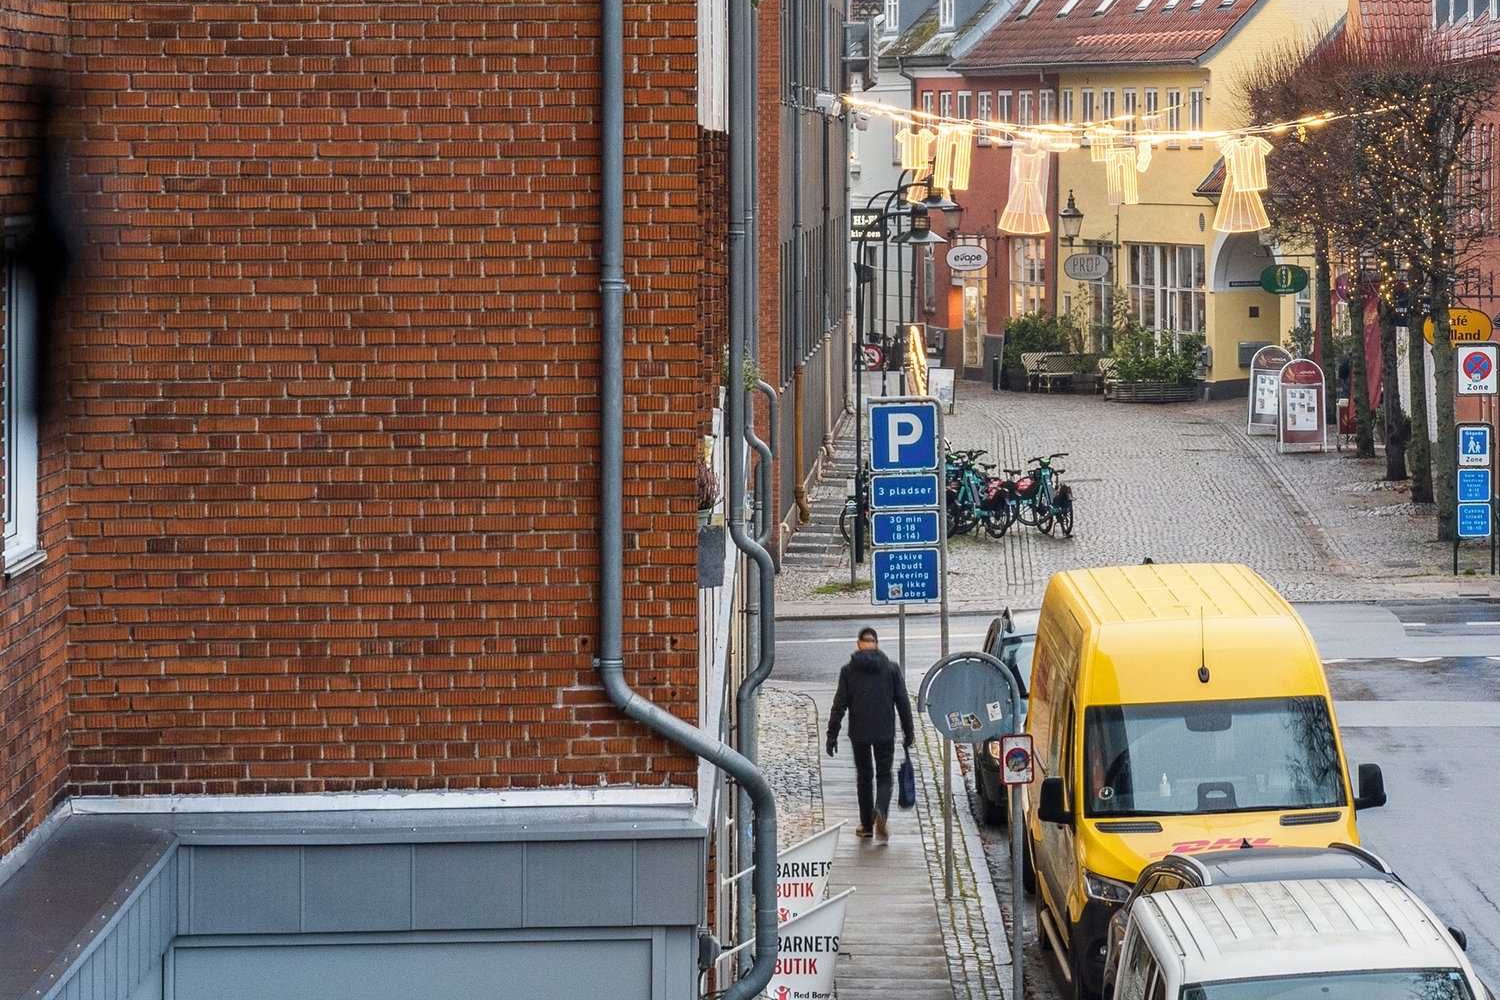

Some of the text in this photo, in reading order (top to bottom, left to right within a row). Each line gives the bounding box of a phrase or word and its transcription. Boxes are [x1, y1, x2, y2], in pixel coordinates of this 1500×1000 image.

[1072, 257, 1101, 272] PROP
[1451, 315, 1468, 326] afé
[1450, 329, 1480, 340] lland
[888, 413, 923, 463] P
[878, 487, 932, 496] 3 pladser
[889, 516, 902, 524] 30
[896, 524, 915, 532] 8-18
[890, 562, 923, 571] påbudt
[884, 572, 929, 580] Parkering
[1170, 838, 1276, 853] DHL
[774, 958, 818, 975] BUTIK
[793, 991, 810, 999] Red
